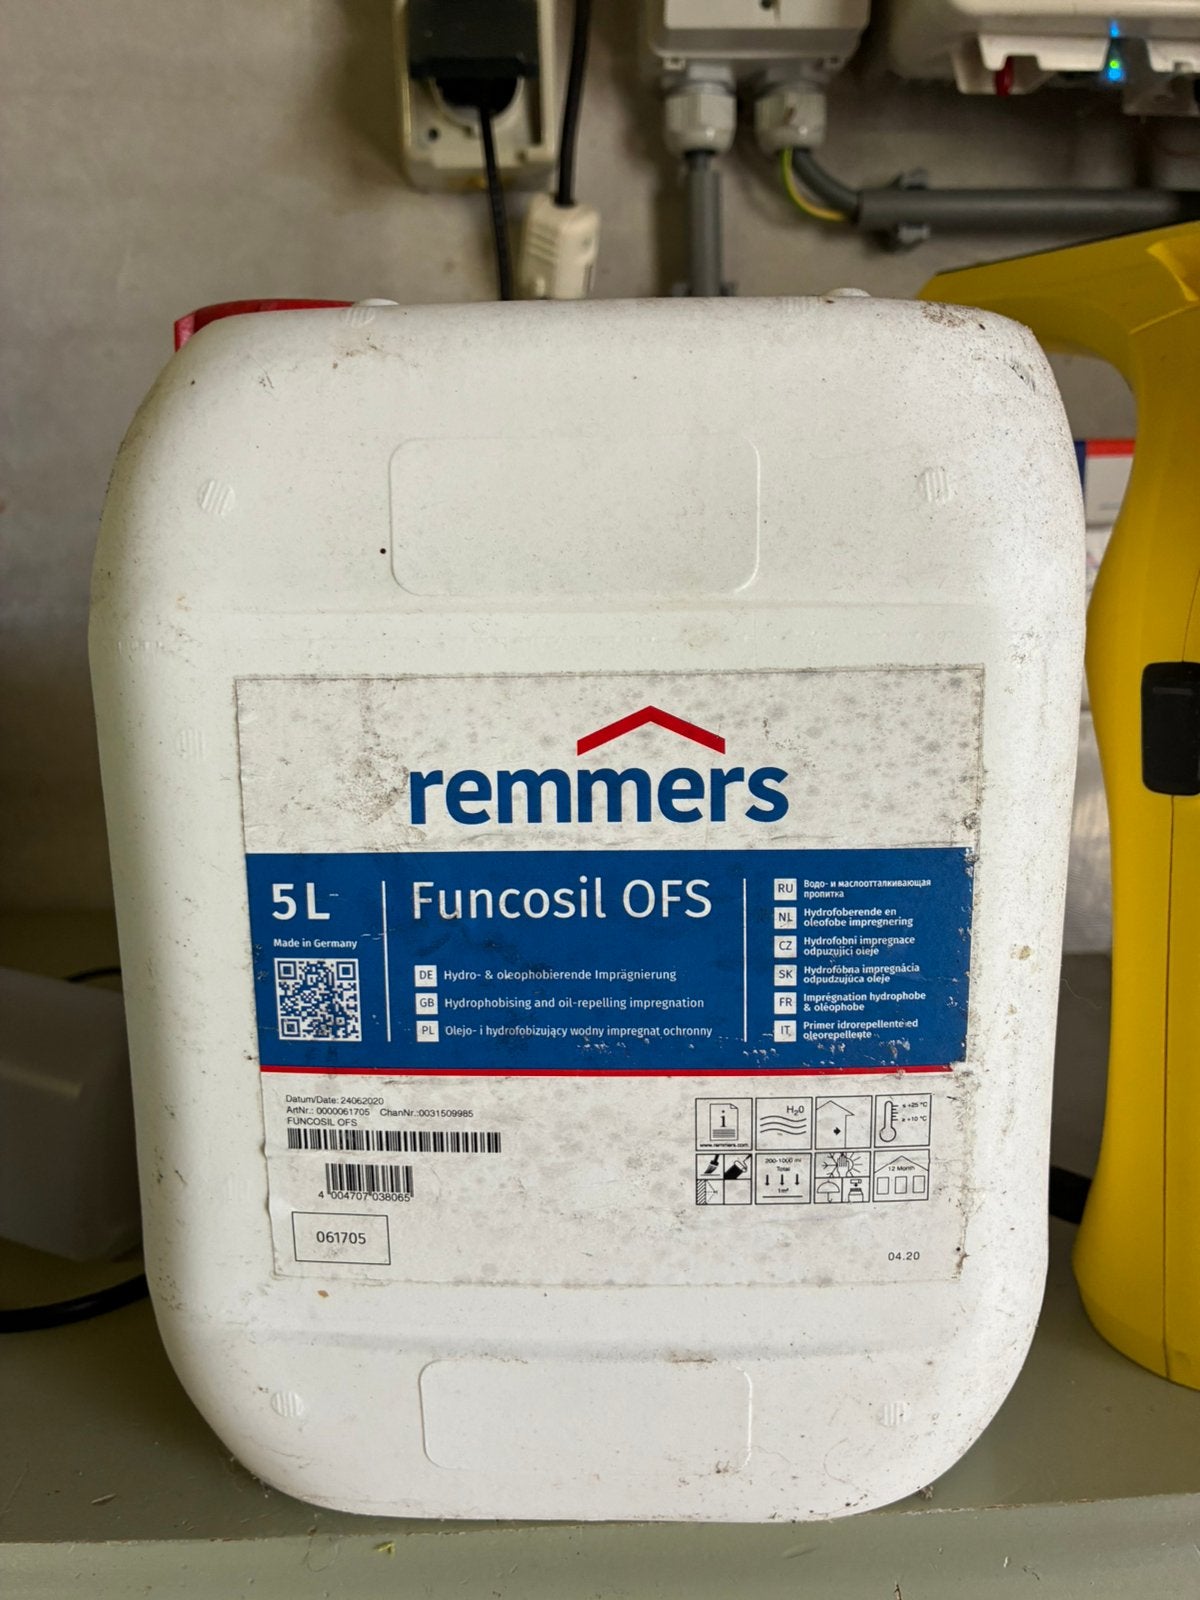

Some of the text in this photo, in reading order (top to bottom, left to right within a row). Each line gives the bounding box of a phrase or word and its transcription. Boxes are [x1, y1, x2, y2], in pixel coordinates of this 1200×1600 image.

[410, 766, 790, 825] remmers
[778, 883, 793, 893] RU
[804, 879, 931, 888] Водо- и маслоотталкивающая
[412, 875, 712, 920] Funcosil OFS
[804, 890, 844, 899] пропитка
[272, 882, 331, 920] 5 L
[778, 912, 793, 923] NL
[804, 908, 882, 918] Hydrofoberende
[804, 916, 914, 928] oleofobe impregnering
[273, 938, 358, 951] Made in Germany
[778, 941, 792, 951] CZ
[860, 935, 916, 947] impregnace
[778, 970, 793, 979] SK
[862, 963, 920, 975] impregnácia
[419, 968, 678, 982] DE Hydro- & oleophobierende Imprägnierung
[804, 974, 891, 985] odpudzujúca oleje
[779, 998, 793, 1007] FR
[804, 991, 926, 1003] Imprégnation hydrophobe
[420, 997, 704, 1010] GB Hydrophobising and oil-repelling impregnation
[804, 1002, 865, 1013] & oléophobe
[804, 1019, 918, 1030] Primer idrorepellente ed
[422, 1025, 712, 1038] PL Olejo- i hydrofobizujący wodny impregnat ochronny
[780, 1026, 791, 1035] IT
[803, 1030, 872, 1041] oleorepellente
[285, 1094, 385, 1105] Datum/Date: 24062020
[286, 1106, 314, 1115] ArtNr.:
[316, 1107, 370, 1116] 0000061705
[287, 1117, 358, 1127] FUNCOSIL OFS
[318, 1191, 411, 1202] 4 004707 038065
[316, 1231, 367, 1245] 061705
[888, 1251, 921, 1261] 04.20
